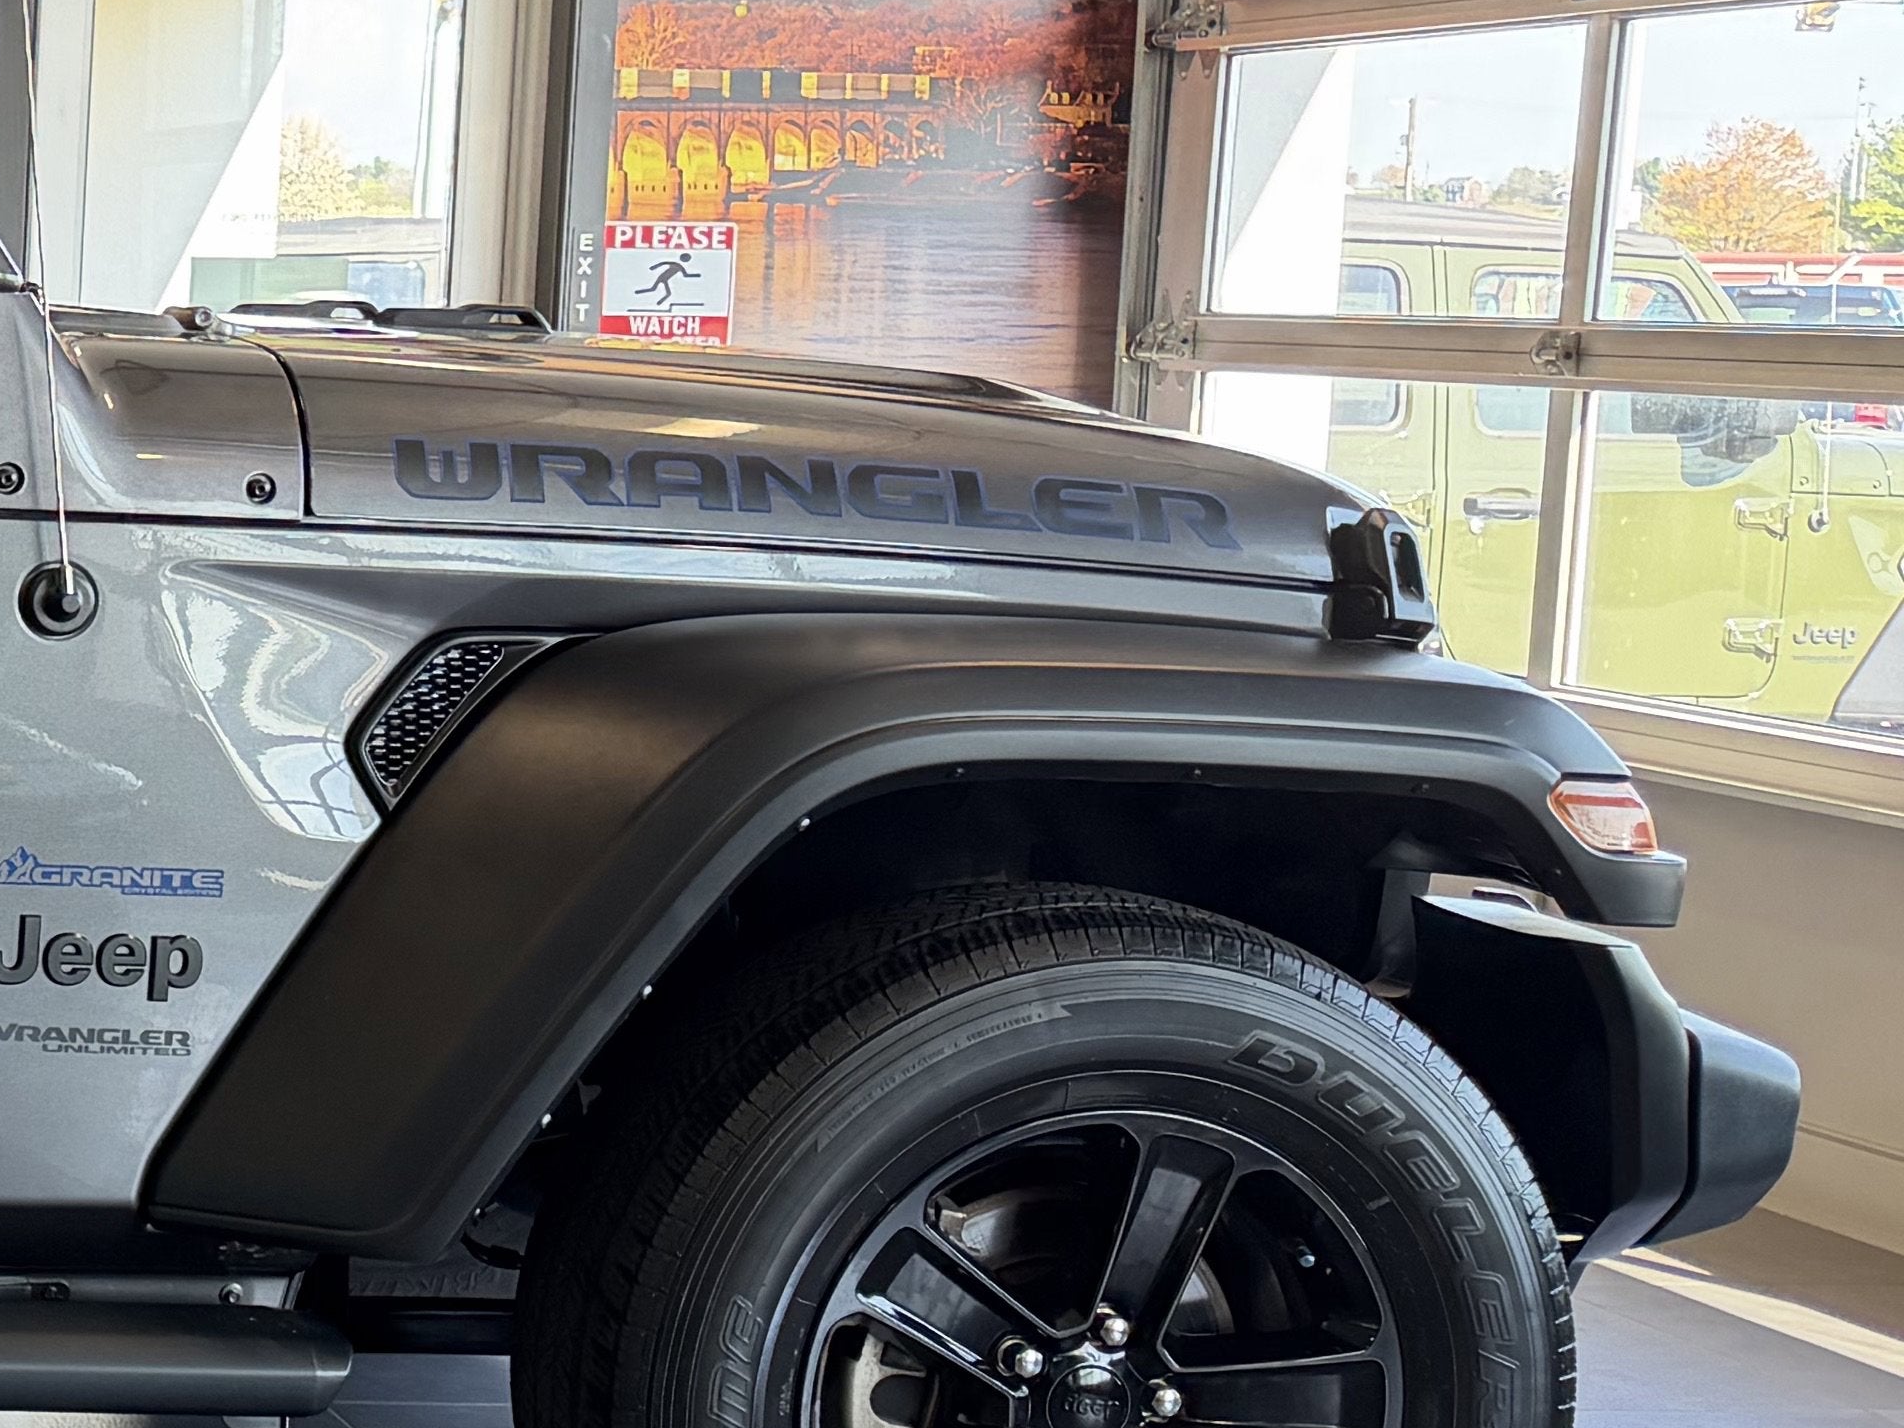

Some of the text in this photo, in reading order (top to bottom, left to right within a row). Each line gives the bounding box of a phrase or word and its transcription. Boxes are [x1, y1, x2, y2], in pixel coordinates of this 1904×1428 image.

[614, 225, 727, 249] PLEASE
[575, 233, 594, 322] EXIT
[629, 315, 701, 335] WATCH
[394, 436, 1245, 551] WRANGLER
[1792, 621, 1856, 649] Jeep
[32, 866, 223, 888] GRANITE
[41, 1043, 191, 1056] UNLIMITED
